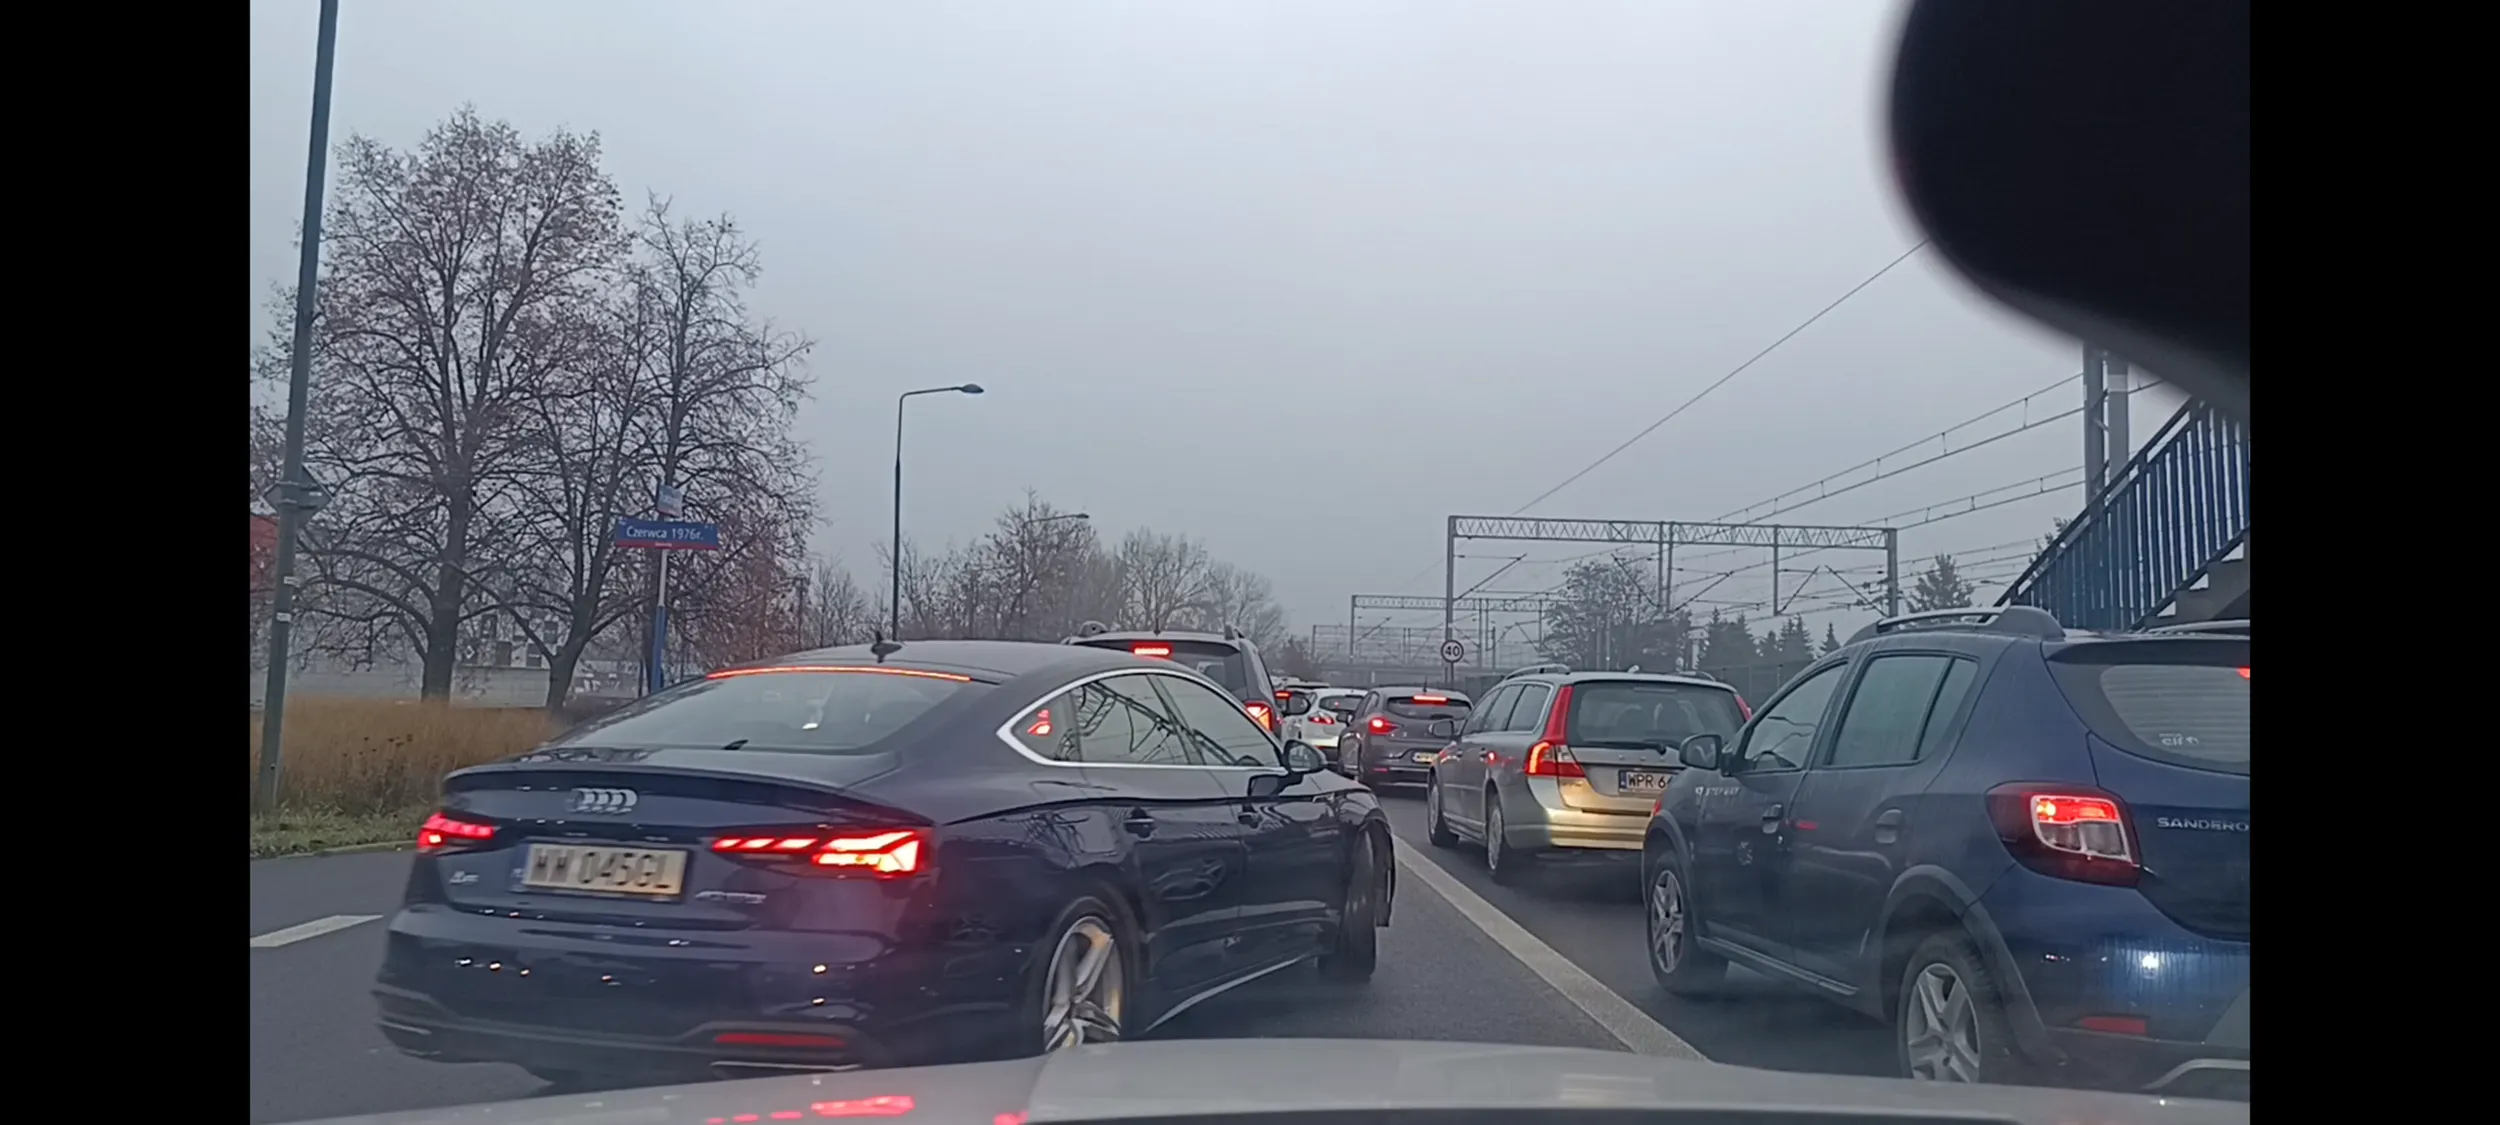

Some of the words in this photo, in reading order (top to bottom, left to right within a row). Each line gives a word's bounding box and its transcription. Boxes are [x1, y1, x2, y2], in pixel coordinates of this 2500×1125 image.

[626, 525, 668, 539] Czerwca
[671, 528, 704, 541] 1976r.
[1445, 645, 1460, 656] 40
[1628, 774, 1654, 788] WPR
[2157, 817, 2249, 832] SANDERO
